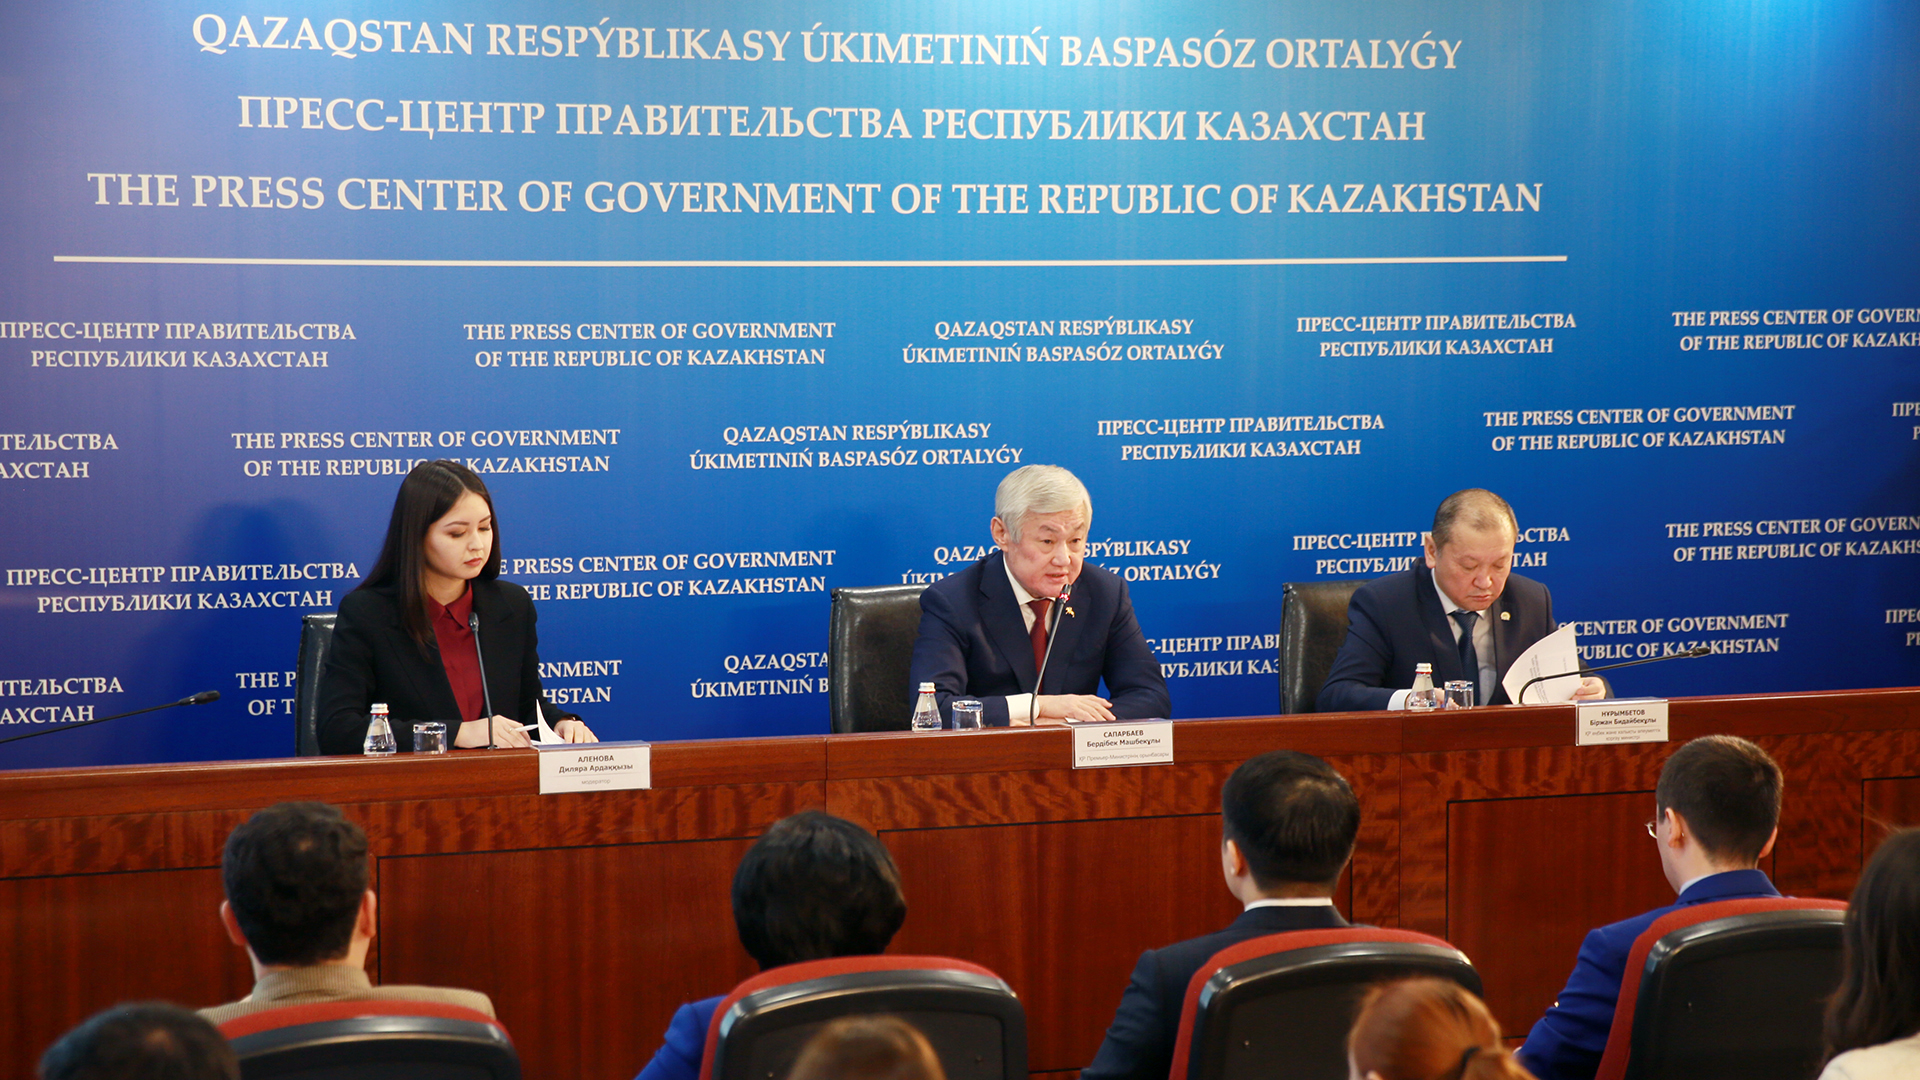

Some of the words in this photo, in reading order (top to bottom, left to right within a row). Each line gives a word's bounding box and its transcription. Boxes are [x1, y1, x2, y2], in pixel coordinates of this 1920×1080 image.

[193, 14, 475, 59] QAZAQSTAN
[486, 17, 791, 61] RESPÝBLIKASY
[801, 22, 1050, 66] ÚKIMETINIŃ
[1060, 29, 1256, 68] BASPASÓZ
[1266, 31, 1462, 70] ORTALYǴY
[238, 96, 545, 140] ПРЕСС-ЦЕНТР
[556, 103, 913, 139] ПРАВИТЕЛЬСТВА
[922, 108, 1187, 140] РЕСПУБЛИКИ
[1196, 111, 1426, 141] КАЗАХСТАН
[87, 173, 179, 206] THE
[192, 175, 324, 209] PRESS
[338, 178, 508, 211] CENTER
[519, 180, 572, 212] OF
[585, 181, 881, 214] GOVERNMENT
[891, 183, 942, 214] OF
[952, 184, 1029, 214] THE
[1038, 183, 1221, 215] REPUBLIC
[1230, 184, 1279, 214] OF
[1287, 183, 1543, 213] KAZAKHSTAN
[935, 320, 1055, 340] QAZAQSTAN
[1059, 315, 1194, 336] RESPÝBLIKASY
[1297, 315, 1422, 334] ПРЕСС-ЦЕНТР
[1425, 313, 1577, 330] ПРАВИТЕЛЬСТВА
[1671, 311, 1706, 326] THE
[1709, 310, 1760, 326] PRESS
[1763, 309, 1829, 325] CENTER
[1832, 309, 1854, 324] OF
[1857, 308, 1920, 324] GOVER
[0, 322, 160, 342] ПРЕСС-ЦЕНТР
[165, 323, 356, 340] ПРАВИТЕЛЬСТВА
[463, 324, 505, 340] THE
[510, 323, 572, 340] PRESS
[577, 323, 657, 340] CENTER
[661, 323, 687, 339] OF
[692, 322, 836, 339] GOVERNMENT
[1680, 335, 1703, 351] OF
[1705, 335, 1740, 350] THE
[1743, 333, 1824, 350] REPUBLIC
[1826, 333, 1849, 348] OF
[1852, 332, 1920, 347] KAZAKH
[475, 351, 502, 367] OF
[507, 351, 549, 367] THE
[553, 350, 651, 367] REPUBLIC
[656, 350, 682, 366] OF
[687, 348, 826, 365] KAZAKHSTAN
[902, 342, 1022, 364] ÚKIMETINIŃ
[1026, 341, 1123, 362] BASPASÓZ
[1126, 340, 1225, 361] ORTALYǴY
[1319, 340, 1442, 357] РЕСПУБЛИКИ
[1445, 338, 1554, 355] КАЗАХСТАН
[31, 351, 187, 367] РЕСПУБЛИКИ
[193, 351, 328, 367] КАЗАХСТАН
[1097, 418, 1226, 437] ПРЕСС-ЦЕНТР
[1229, 414, 1385, 433] ПРАВИТЕЛЬСТВА
[1483, 411, 1519, 427] THE
[1522, 410, 1574, 426] PRESS
[1577, 408, 1644, 425] CENTER
[1647, 408, 1670, 423] OF
[1673, 405, 1796, 422] GOVERNMENT
[0, 434, 119, 450] ТЕЛЬСТВА
[231, 433, 275, 449] THE
[281, 432, 345, 448] PRESS
[350, 431, 434, 448] CENTER
[438, 431, 466, 447] OF
[471, 429, 621, 447] GOVERNMENT
[723, 425, 848, 446] QAZAQSTAN
[852, 420, 991, 440] RESPÝBLIKASY
[1492, 436, 1515, 451] OF
[1518, 435, 1554, 450] THE
[1557, 432, 1639, 449] REPUBLIC
[1642, 432, 1666, 447] OF
[1668, 429, 1786, 447] KAZAKHSTAN
[689, 447, 814, 470] ÚKIMETINIŃ
[818, 445, 918, 467] BASPASÓZ
[922, 444, 1023, 465] ORTALYǴY
[1121, 442, 1247, 461] РЕСПУБЛИКИ
[1250, 439, 1361, 458] КАЗАХСТАН
[0, 462, 89, 479] АХСТАН
[244, 460, 272, 477] OF
[277, 460, 321, 476] THE
[465, 456, 611, 474] KAZAKHSTAN
[1665, 523, 1700, 538] THE
[1703, 521, 1753, 537] PRESS
[1756, 519, 1821, 535] CENTER
[1824, 518, 1847, 533] OF
[1850, 516, 1920, 532] GOVERN
[1083, 537, 1191, 558] SPÝBLIKASY
[1293, 532, 1417, 551] ПРЕСС-ЦЕНТР
[1673, 547, 1696, 562] OF
[1699, 545, 1733, 561] THE
[1736, 543, 1817, 560] REPUBLIC
[1819, 542, 1842, 557] OF
[513, 557, 574, 574] PRESS
[578, 555, 658, 573] CENTER
[662, 554, 689, 570] OF
[693, 550, 836, 569] GOVERNMENT
[1124, 560, 1221, 582] ORTALYǴY
[1316, 556, 1416, 574] РЕСПУБЛИ
[6, 567, 165, 587] ПРЕСС-ЦЕНТР
[170, 563, 360, 582] ПРАВИТЕЛЬСТВА
[522, 584, 551, 600] HE
[555, 581, 653, 600] REPUBLIC
[657, 580, 684, 597] OF
[688, 576, 826, 595] KAZAKHSTAN
[37, 594, 192, 613] РЕСПУБЛИКИ
[197, 590, 332, 609] КАЗАХСТАН
[1574, 619, 1638, 636] CENTER
[1641, 618, 1664, 634] OF
[1667, 613, 1789, 632] GOVERNMENT
[1636, 642, 1659, 658] OF
[724, 652, 829, 674] QAZAQSTA
[236, 672, 279, 688] THE
[537, 660, 622, 679] RNMENT
[0, 677, 124, 696] ТЕЛЬСТВА
[690, 674, 813, 698] ÚKIMETINIŃ
[248, 699, 276, 716] OF
[542, 686, 611, 704] HSTAN
[0, 705, 94, 724] АХСТАН
[1086, 740, 1118, 748] Бердібек
[1103, 730, 1144, 738] САПАРБАЕВ
[559, 765, 588, 774] Диляра
[577, 755, 615, 763] АЛЕНОВА
